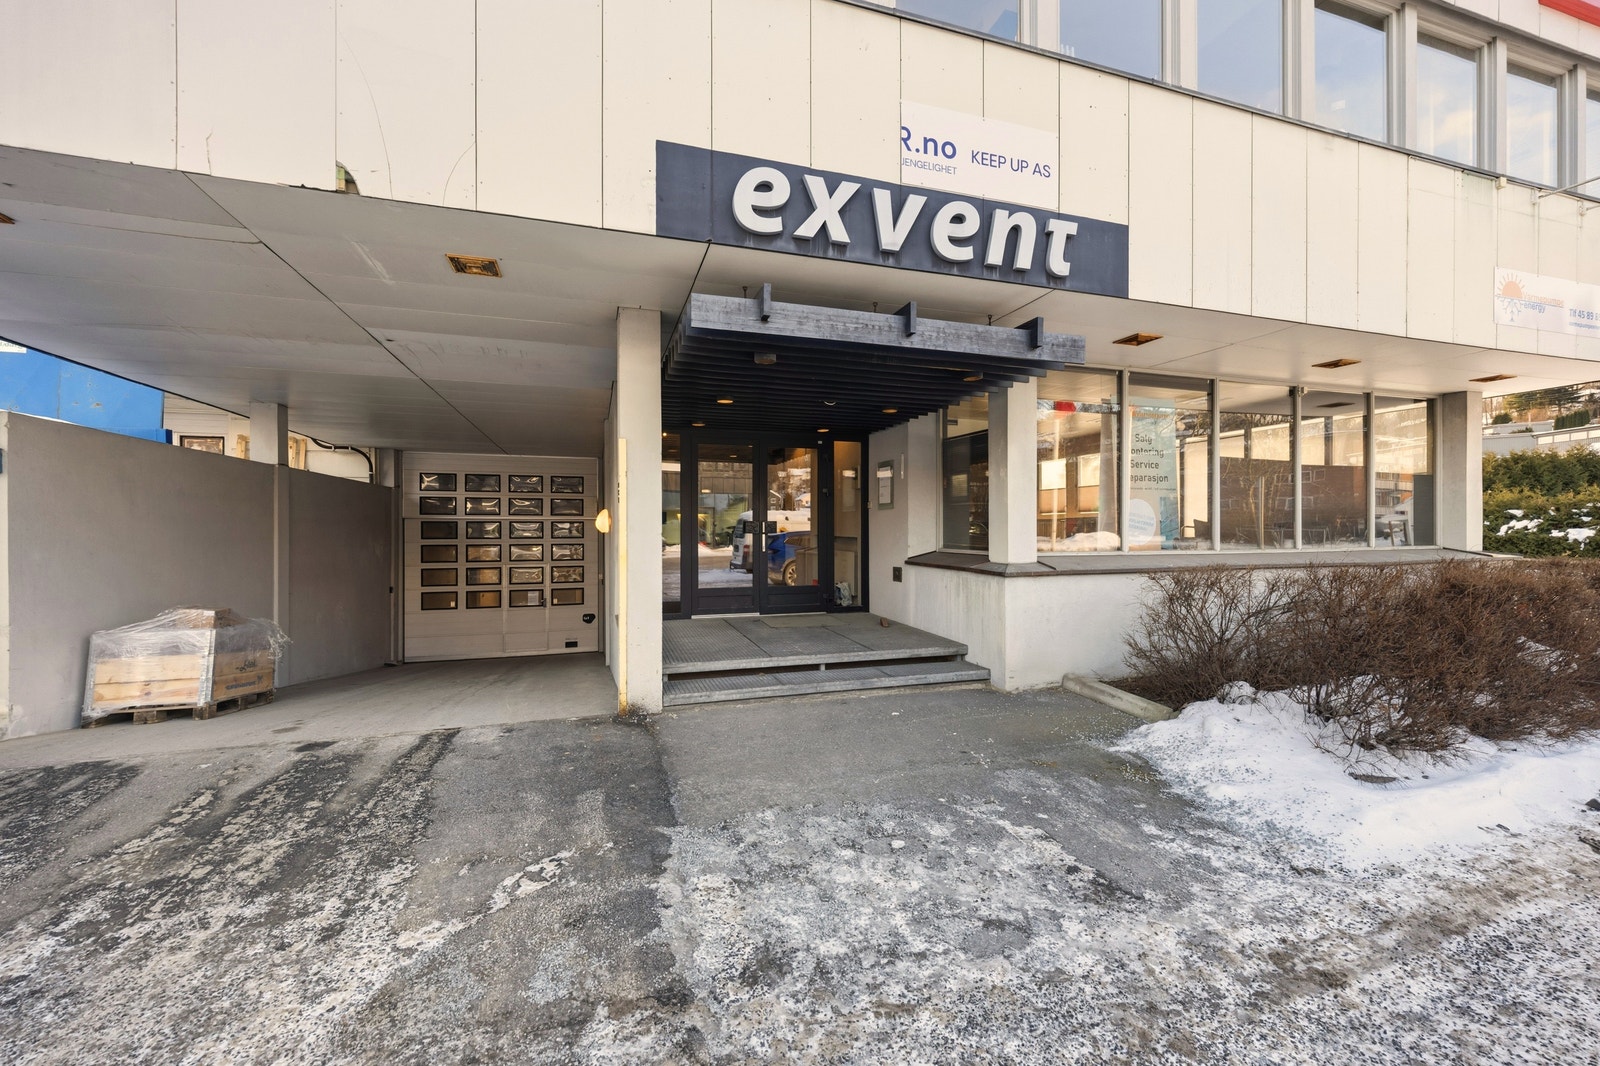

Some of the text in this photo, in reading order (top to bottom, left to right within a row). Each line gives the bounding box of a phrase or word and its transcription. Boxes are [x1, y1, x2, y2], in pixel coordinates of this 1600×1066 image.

[971, 150, 1051, 178] KEEP UP AS
[732, 166, 1078, 278] exvent
[1577, 310, 1586, 319] 45
[1130, 447, 1164, 459] ontering
[1130, 459, 1160, 469] Service
[1130, 473, 1169, 484] eparasjon
